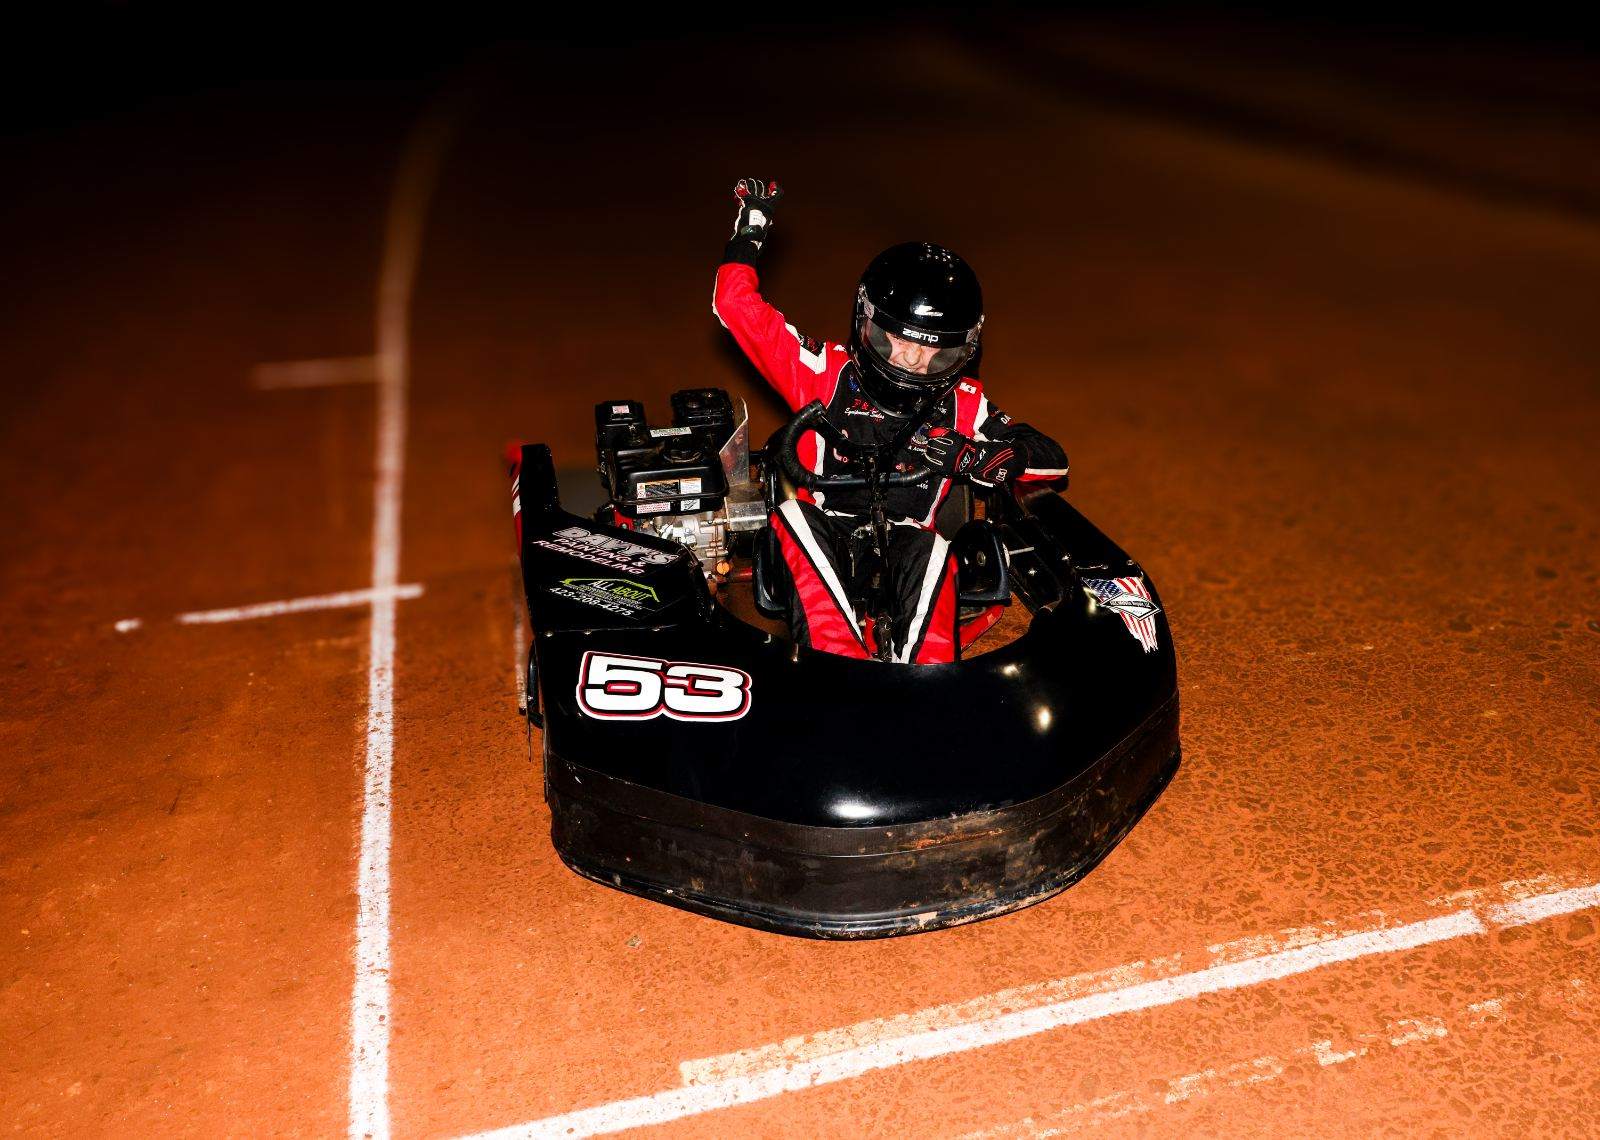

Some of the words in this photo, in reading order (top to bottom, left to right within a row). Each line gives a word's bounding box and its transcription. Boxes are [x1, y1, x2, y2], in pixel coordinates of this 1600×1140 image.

[902, 327, 939, 343] zamp
[532, 540, 645, 574] REMODELING
[553, 538, 632, 562] PAINTING
[588, 579, 615, 591] ALL
[609, 586, 653, 601] ABOUT
[576, 650, 752, 722] 53
